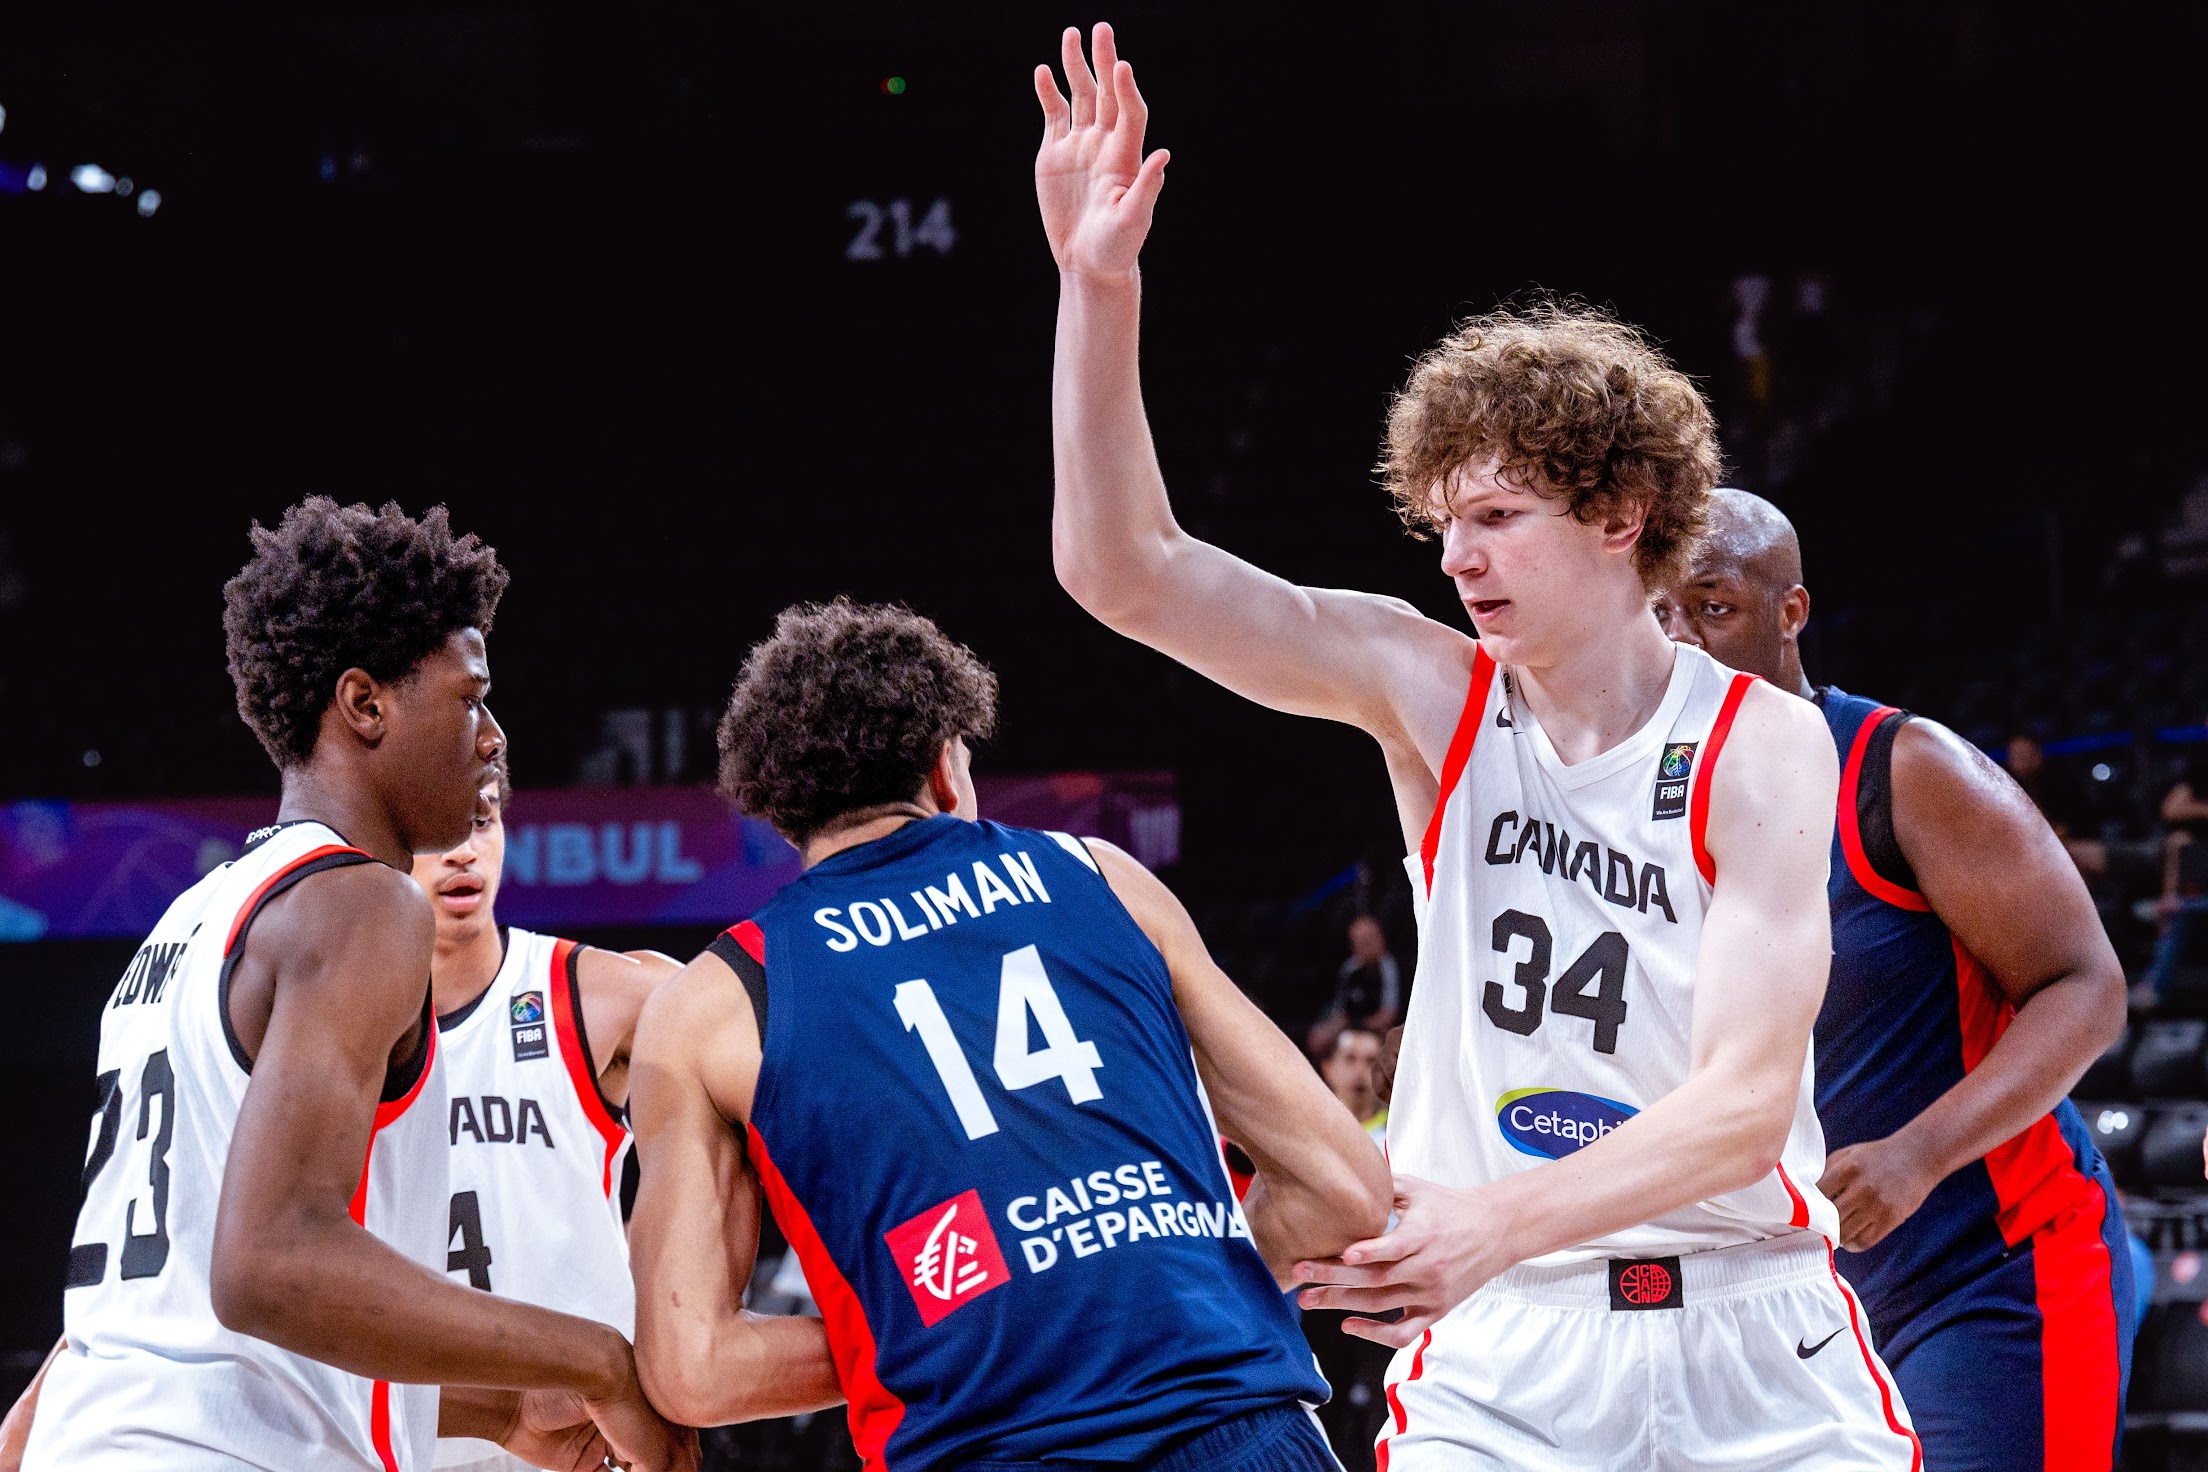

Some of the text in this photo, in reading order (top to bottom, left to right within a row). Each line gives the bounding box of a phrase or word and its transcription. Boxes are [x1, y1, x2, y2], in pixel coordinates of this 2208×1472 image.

[847, 199, 957, 259] 214
[1659, 784, 1685, 800] FIBA
[813, 851, 1052, 953] SOLIMAN
[1484, 810, 1678, 924] CANADA
[1482, 908, 1629, 1055] 34
[516, 1027, 543, 1045] FIBA
[892, 943, 1105, 1141] 14
[63, 1046, 175, 1290] 23
[1006, 1160, 1173, 1232] CAISSE
[447, 1190, 492, 1293] 4
